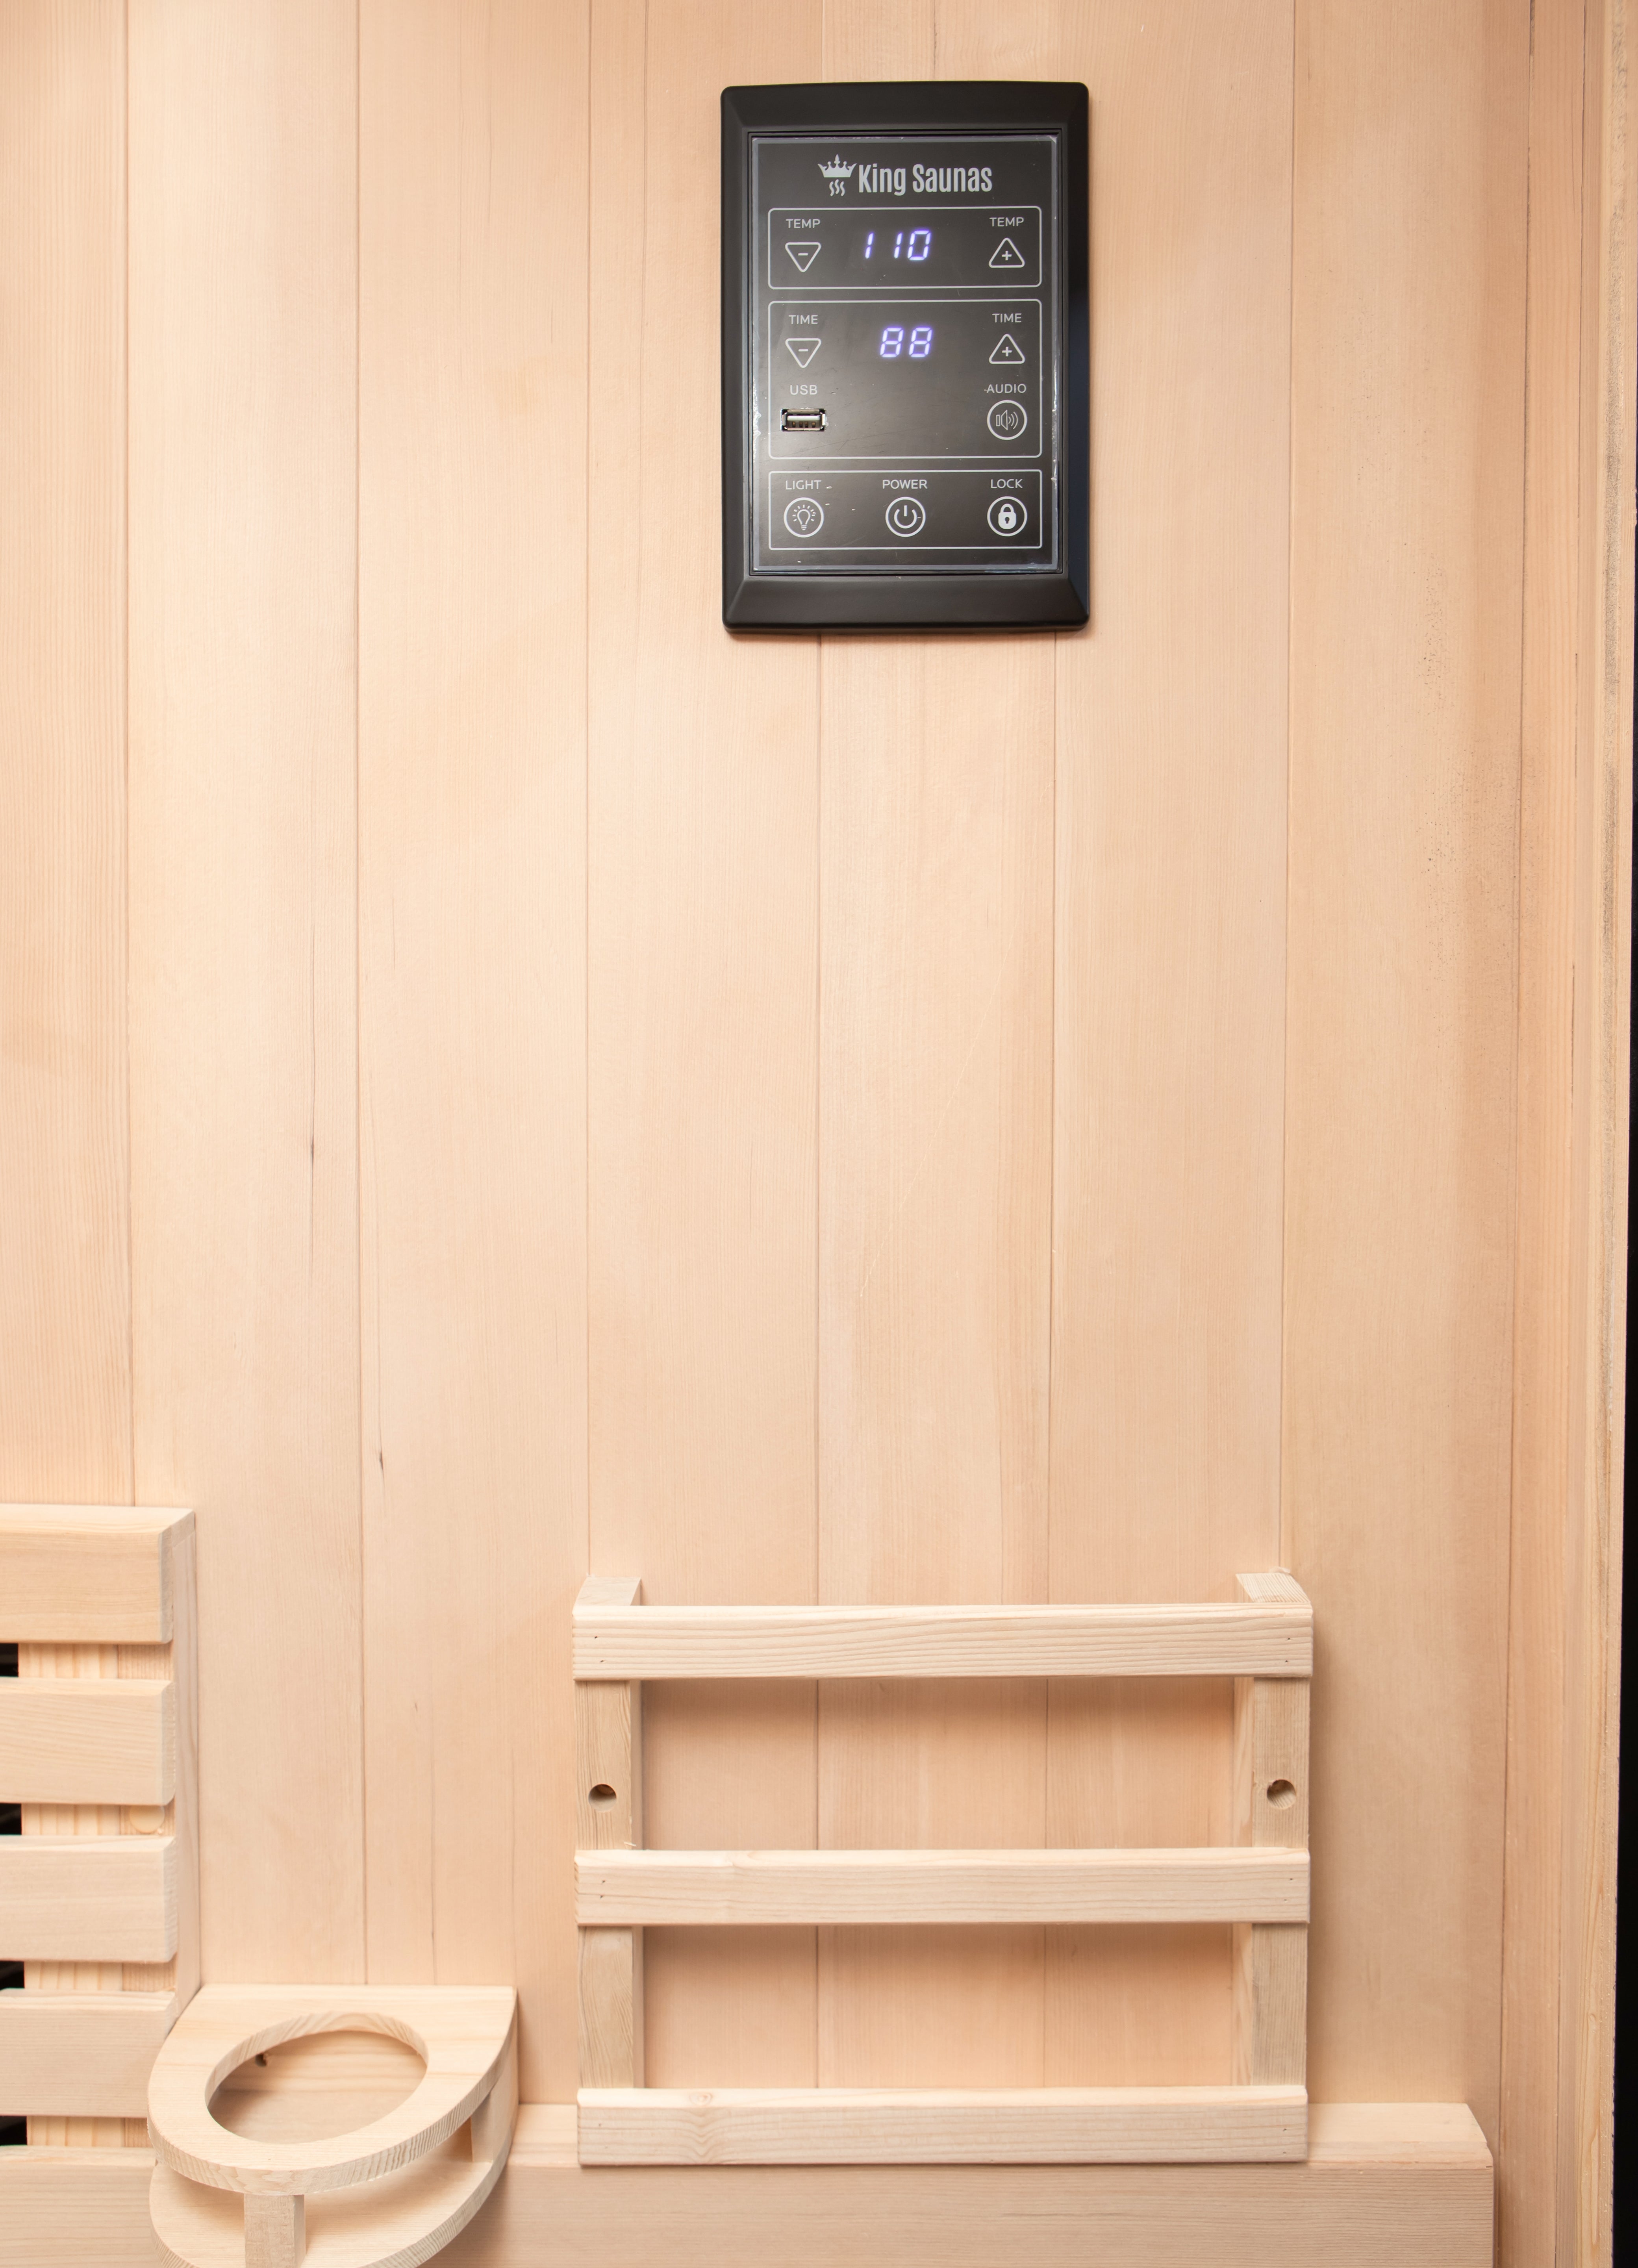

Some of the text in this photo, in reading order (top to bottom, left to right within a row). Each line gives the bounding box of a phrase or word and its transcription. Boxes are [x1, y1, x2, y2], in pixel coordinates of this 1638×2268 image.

[858, 163, 993, 196] King Saunas
[786, 219, 821, 229] TEMP
[989, 217, 1025, 227] TEMP
[864, 229, 932, 261] 110
[789, 315, 818, 325] TIME
[992, 313, 1022, 323] TIME
[880, 327, 932, 358] 88
[790, 384, 818, 395] USB
[987, 384, 1027, 394] AUDIO
[786, 480, 822, 490] LIGHT
[882, 479, 928, 489] POWER
[991, 479, 1023, 489] LOCK
